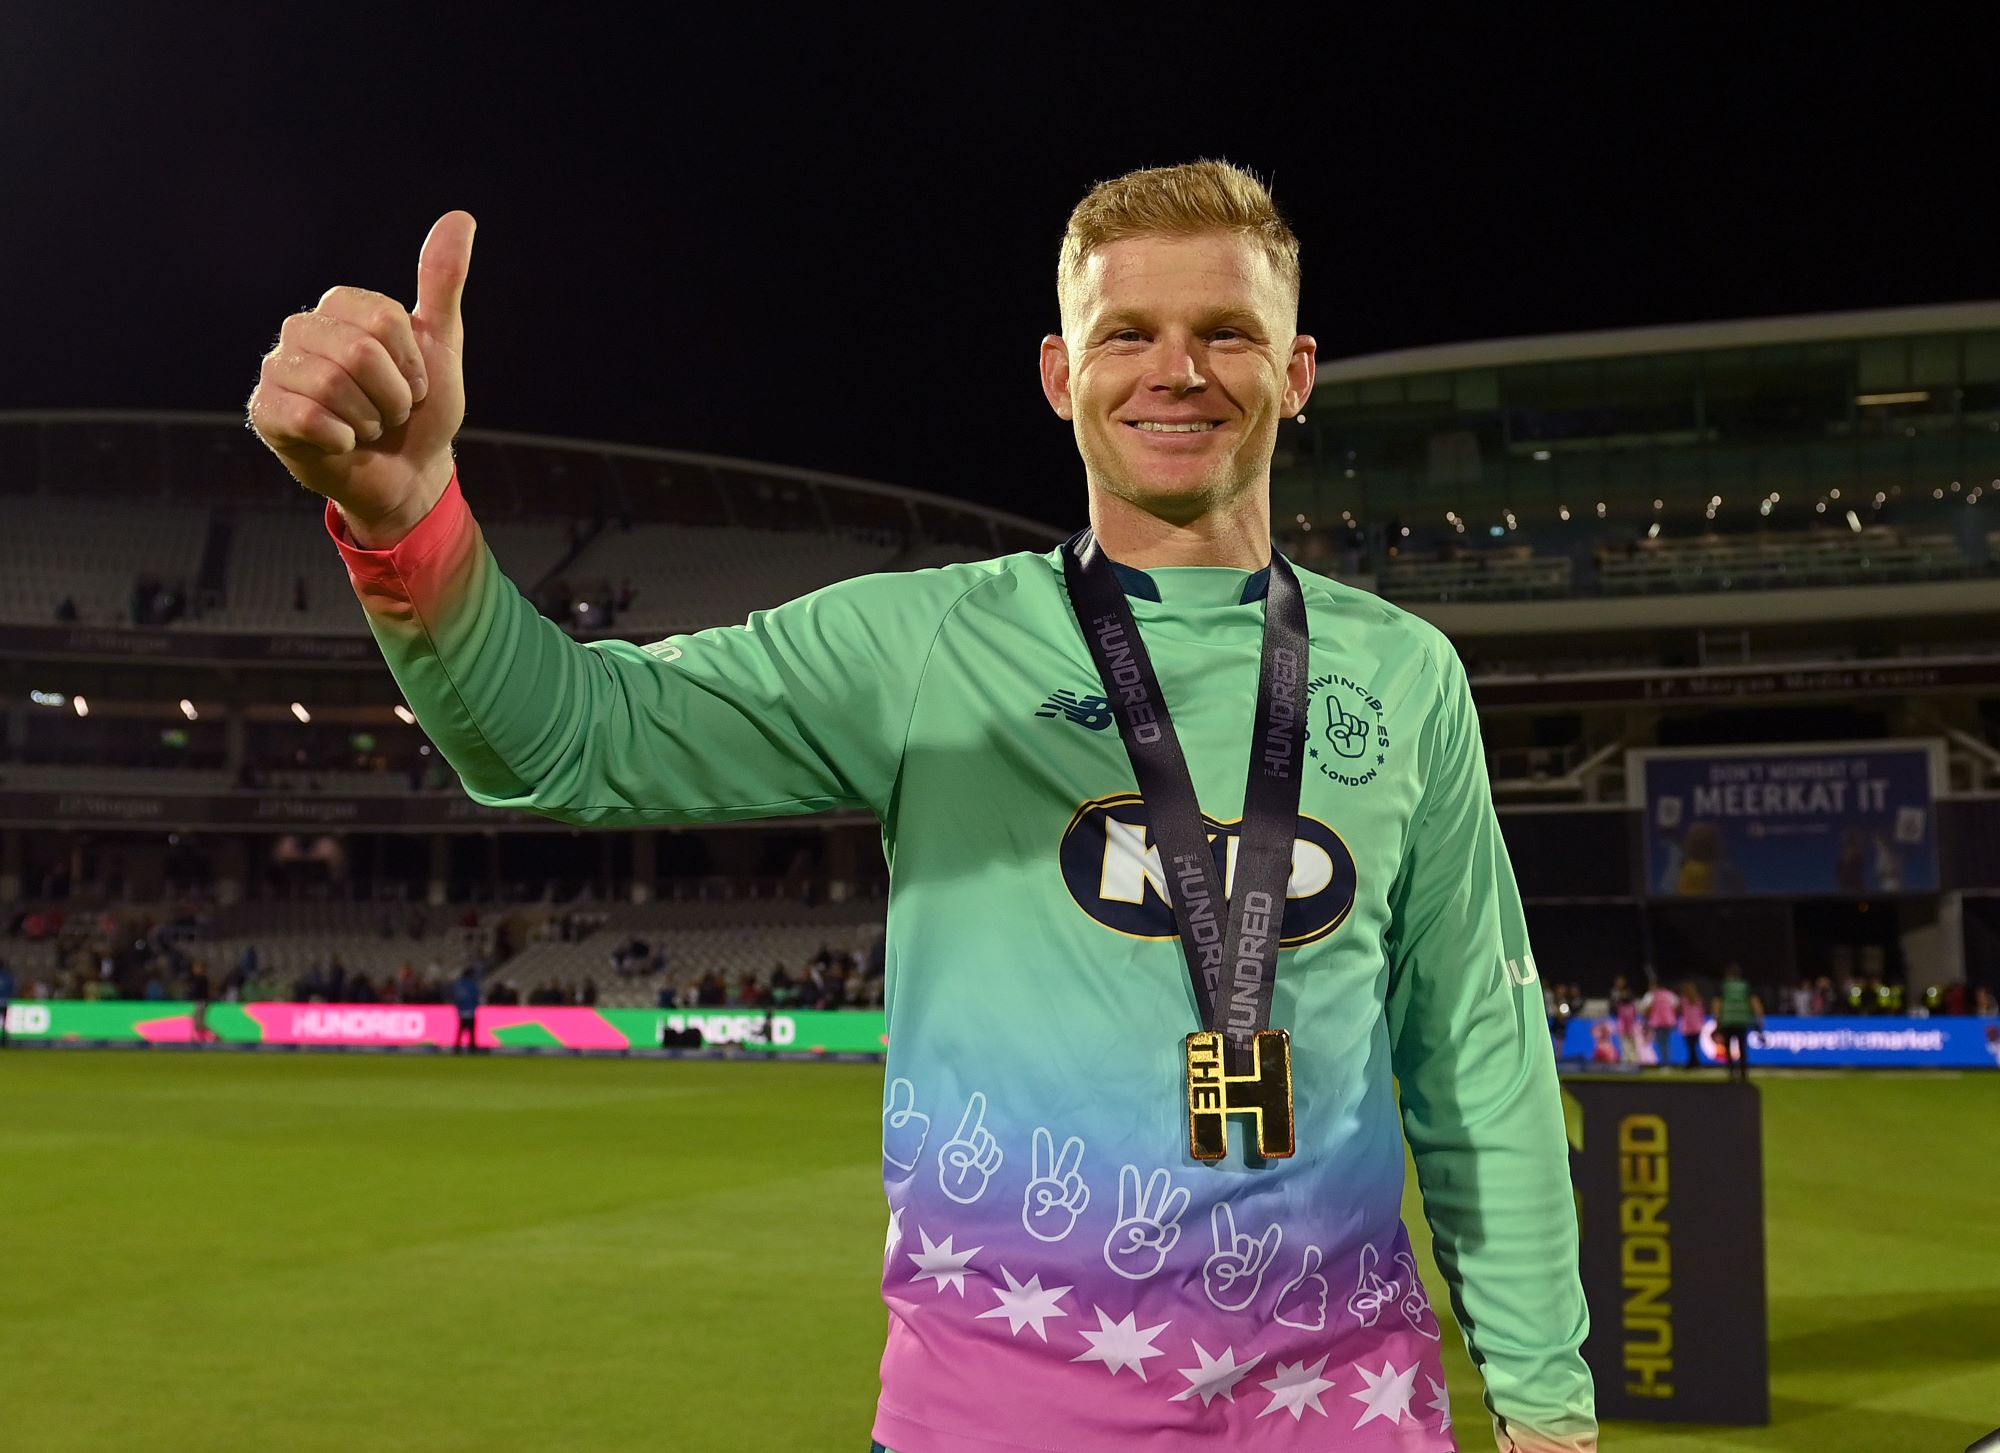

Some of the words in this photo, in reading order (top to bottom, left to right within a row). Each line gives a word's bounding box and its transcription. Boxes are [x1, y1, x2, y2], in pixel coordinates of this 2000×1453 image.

[1093, 617, 1161, 744] HUNDRED
[1265, 647, 1297, 778] HUNDRED
[1307, 675, 1389, 748] INVINCIBLES
[1320, 763, 1377, 786] LONDON
[1693, 780, 1847, 817] MEERKAT
[1857, 778, 1889, 813] IT
[1173, 855, 1224, 1008] HUNDRE
[1227, 891, 1273, 1051] HUNDRED
[292, 1010, 425, 1037] HUNDRED
[1191, 1037, 1220, 1110] THE
[1619, 1113, 1674, 1398] HUNDRED
